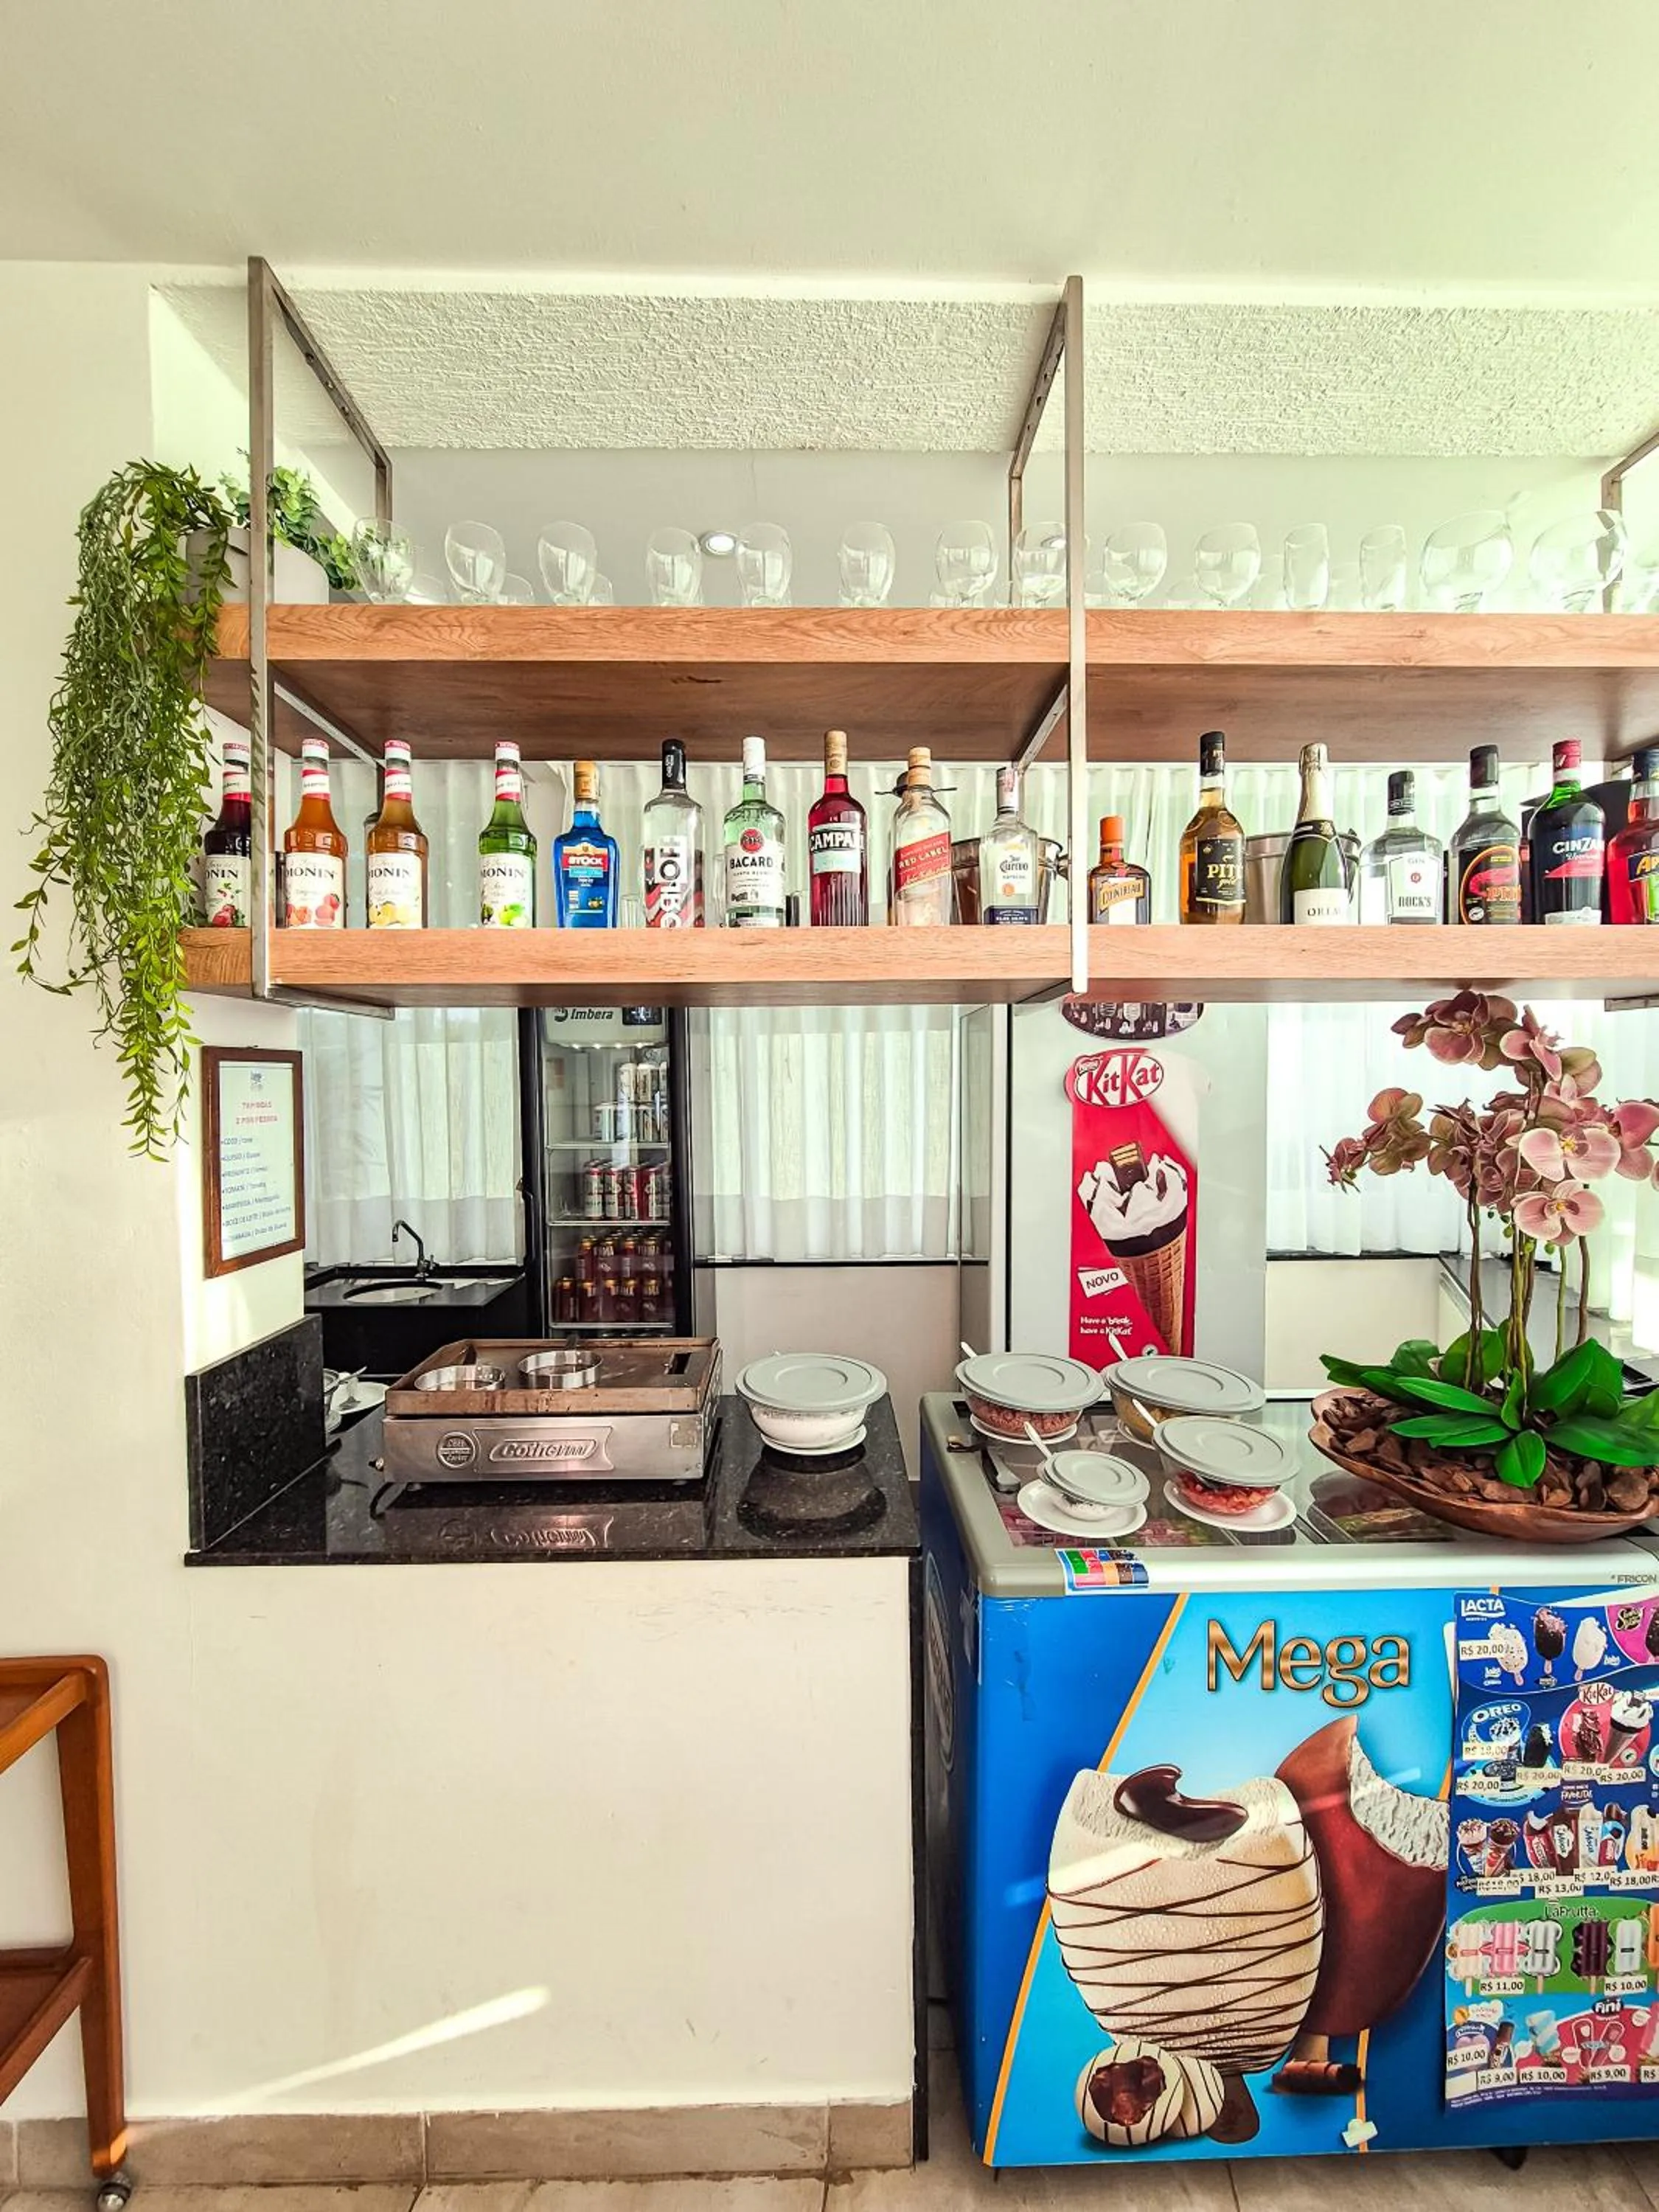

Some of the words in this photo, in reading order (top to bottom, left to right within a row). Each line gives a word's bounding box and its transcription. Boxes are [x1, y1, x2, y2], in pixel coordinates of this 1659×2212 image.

[810, 832, 864, 851] CAMPAI
[1552, 837, 1604, 854] CINZA
[730, 856, 774, 869] BACARD
[206, 869, 238, 879] NIN
[1207, 863, 1242, 879] PIT
[571, 1008, 613, 1020] Imbera
[1086, 1055, 1160, 1105] KitKat
[1086, 1272, 1119, 1289] NOVO
[1080, 1316, 1099, 1324] Have
[1617, 1574, 1658, 1584] FRICON
[1461, 1598, 1505, 1618] LACTA
[1461, 1645, 1474, 1656] R$
[1476, 1644, 1503, 1656] 20,00
[1207, 1619, 1410, 1708] Mega
[1472, 1703, 1522, 1723] OREO
[1580, 1767, 1607, 1775] 20,0
[1600, 1773, 1613, 1783] R$
[1615, 1770, 1644, 1781] 20,00
[1457, 1781, 1470, 1792] R$
[1472, 1781, 1500, 1791] 20,00
[1590, 1870, 1615, 1881] 12,0
[1610, 1877, 1621, 1887] R$
[1625, 1876, 1650, 1886] 18,00
[1539, 1885, 1551, 1894] R$
[1481, 1982, 1493, 1992] R$
[1496, 1981, 1523, 1992] 11,00
[1605, 1981, 1617, 1992] R$
[1621, 1980, 1646, 1991] 10,00
[1447, 2056, 1458, 2065] R$
[1461, 2049, 1486, 2062] 10,00
[1521, 2072, 1534, 2081] R$
[1537, 2070, 1565, 2081] 10,00
[1590, 2070, 1602, 2079] R$
[1605, 2068, 1627, 2079] 9,00
